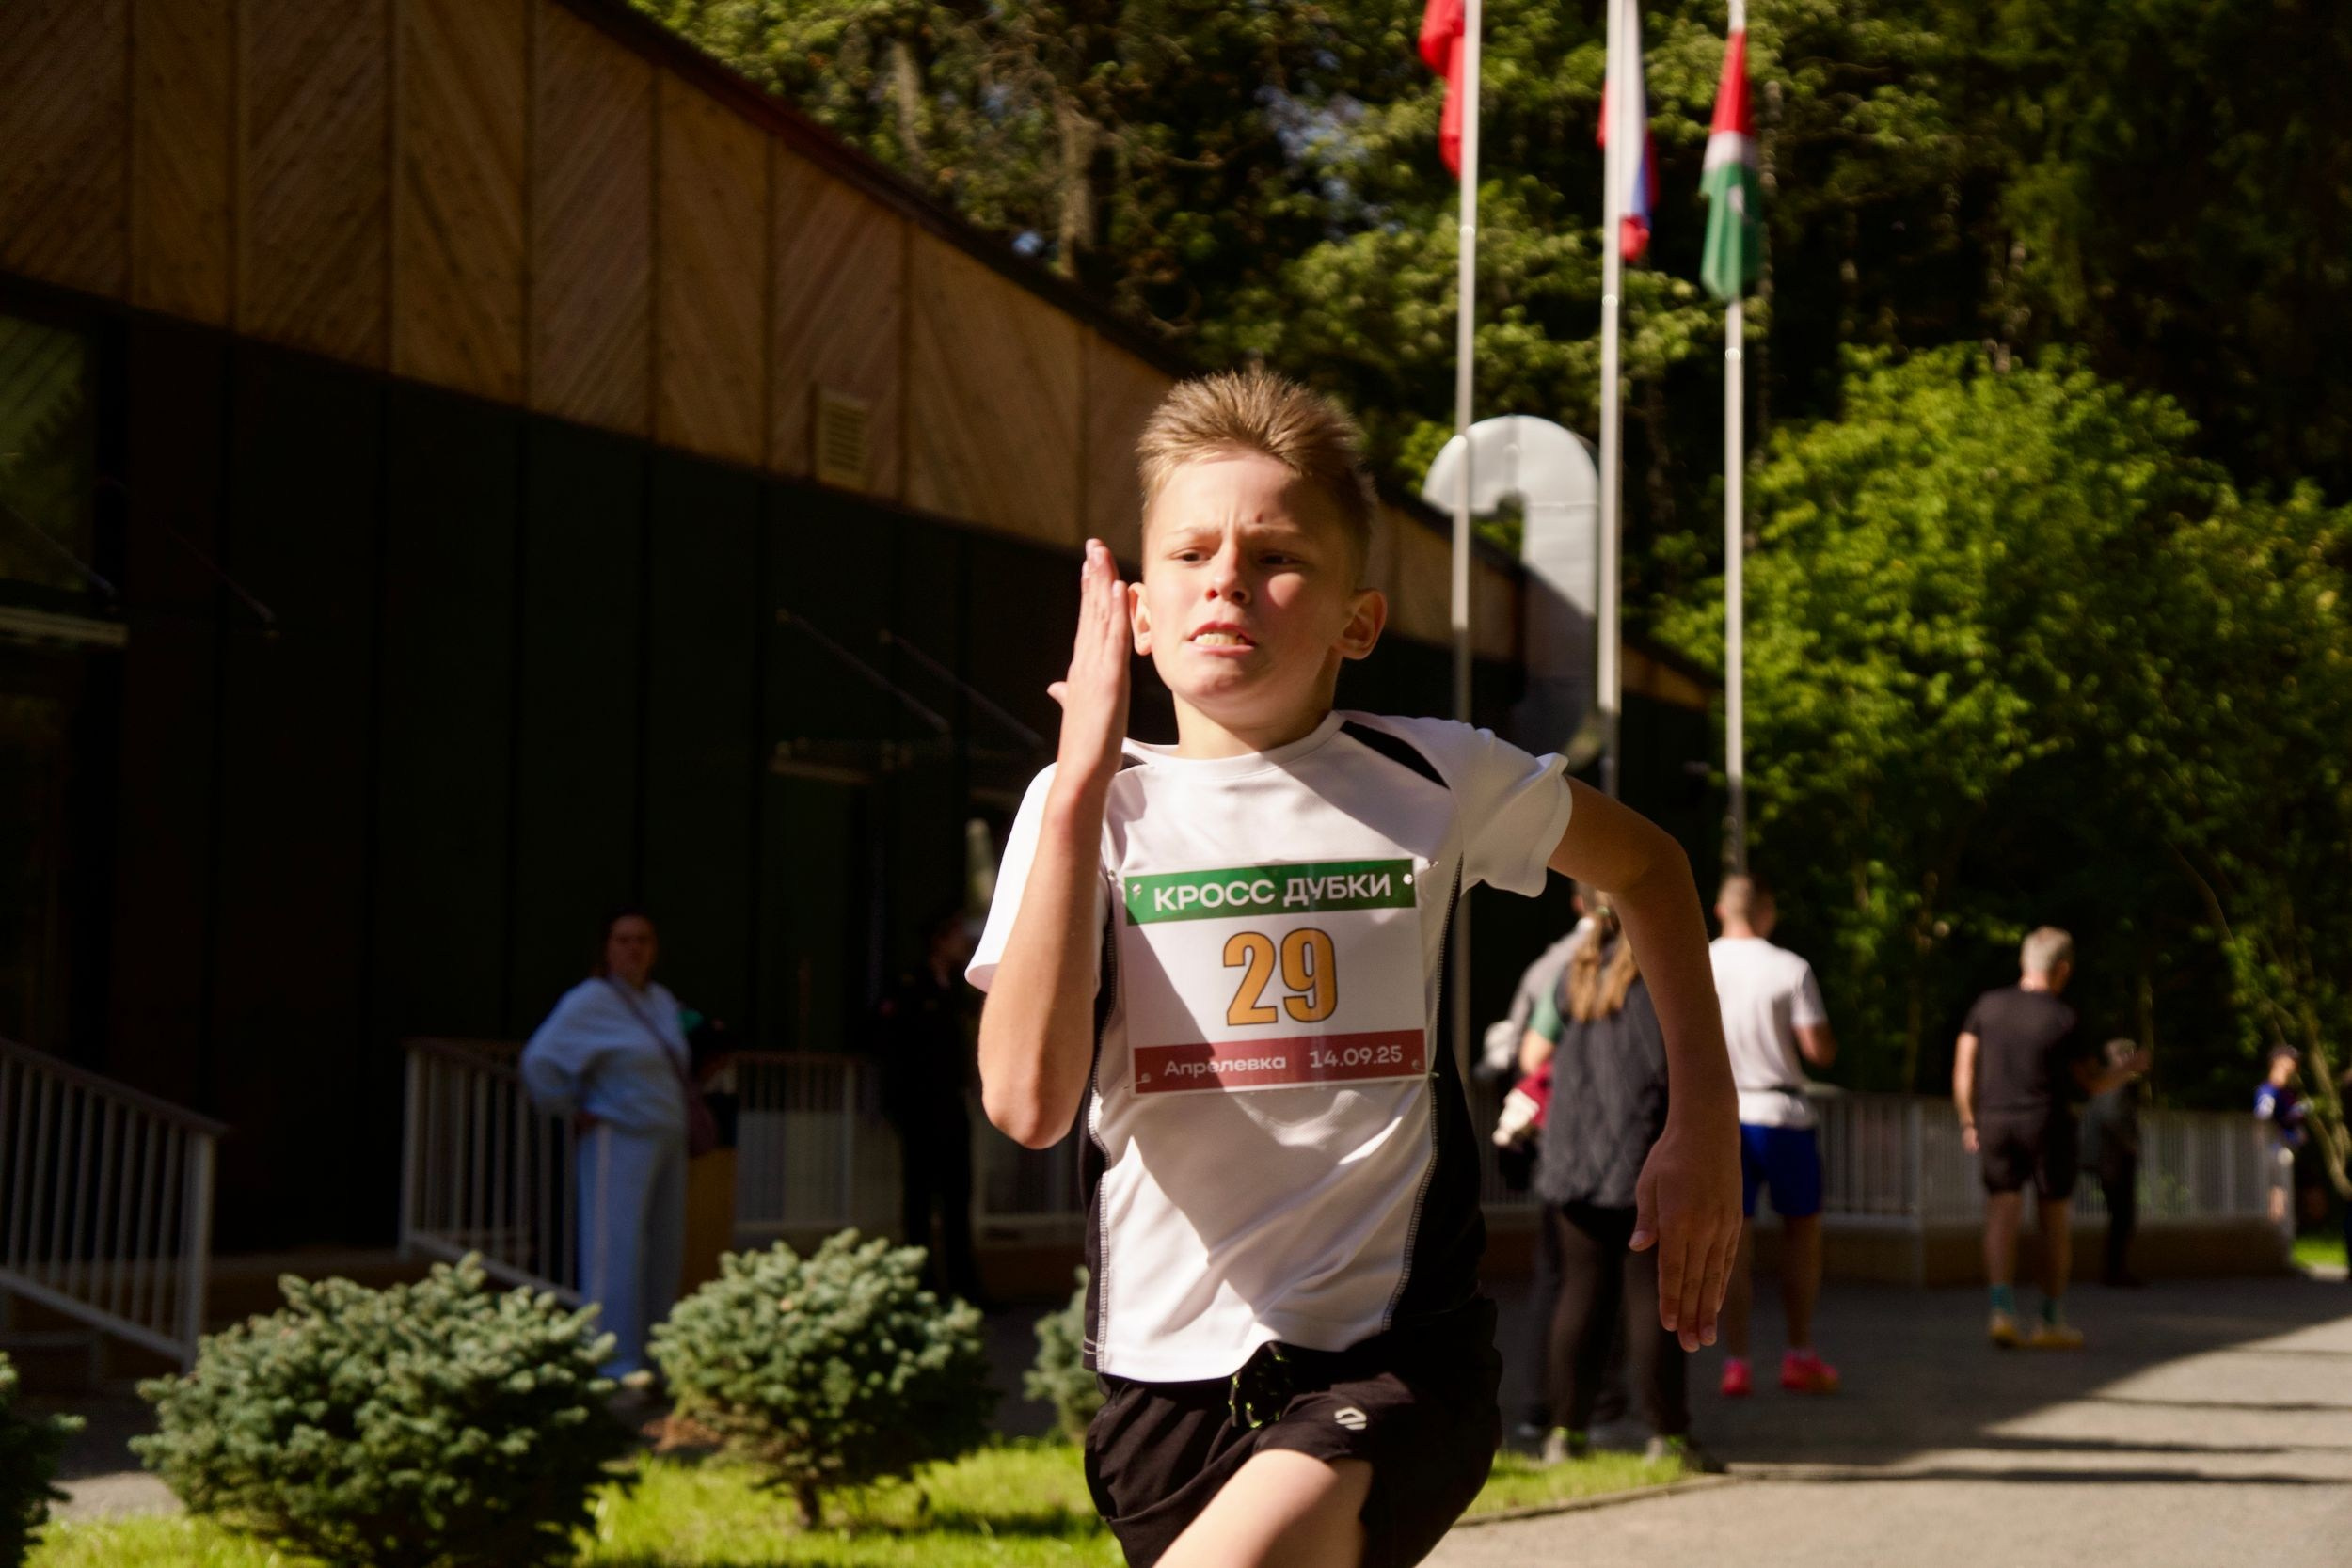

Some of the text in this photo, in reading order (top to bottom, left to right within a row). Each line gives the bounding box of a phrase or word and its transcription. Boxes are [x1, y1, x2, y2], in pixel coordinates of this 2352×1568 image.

[1153, 873, 1392, 911] КРОСС ДУБКИ
[1222, 927, 1338, 1026] 29
[1164, 1045, 1404, 1078] Апрелевка 14.09.25
